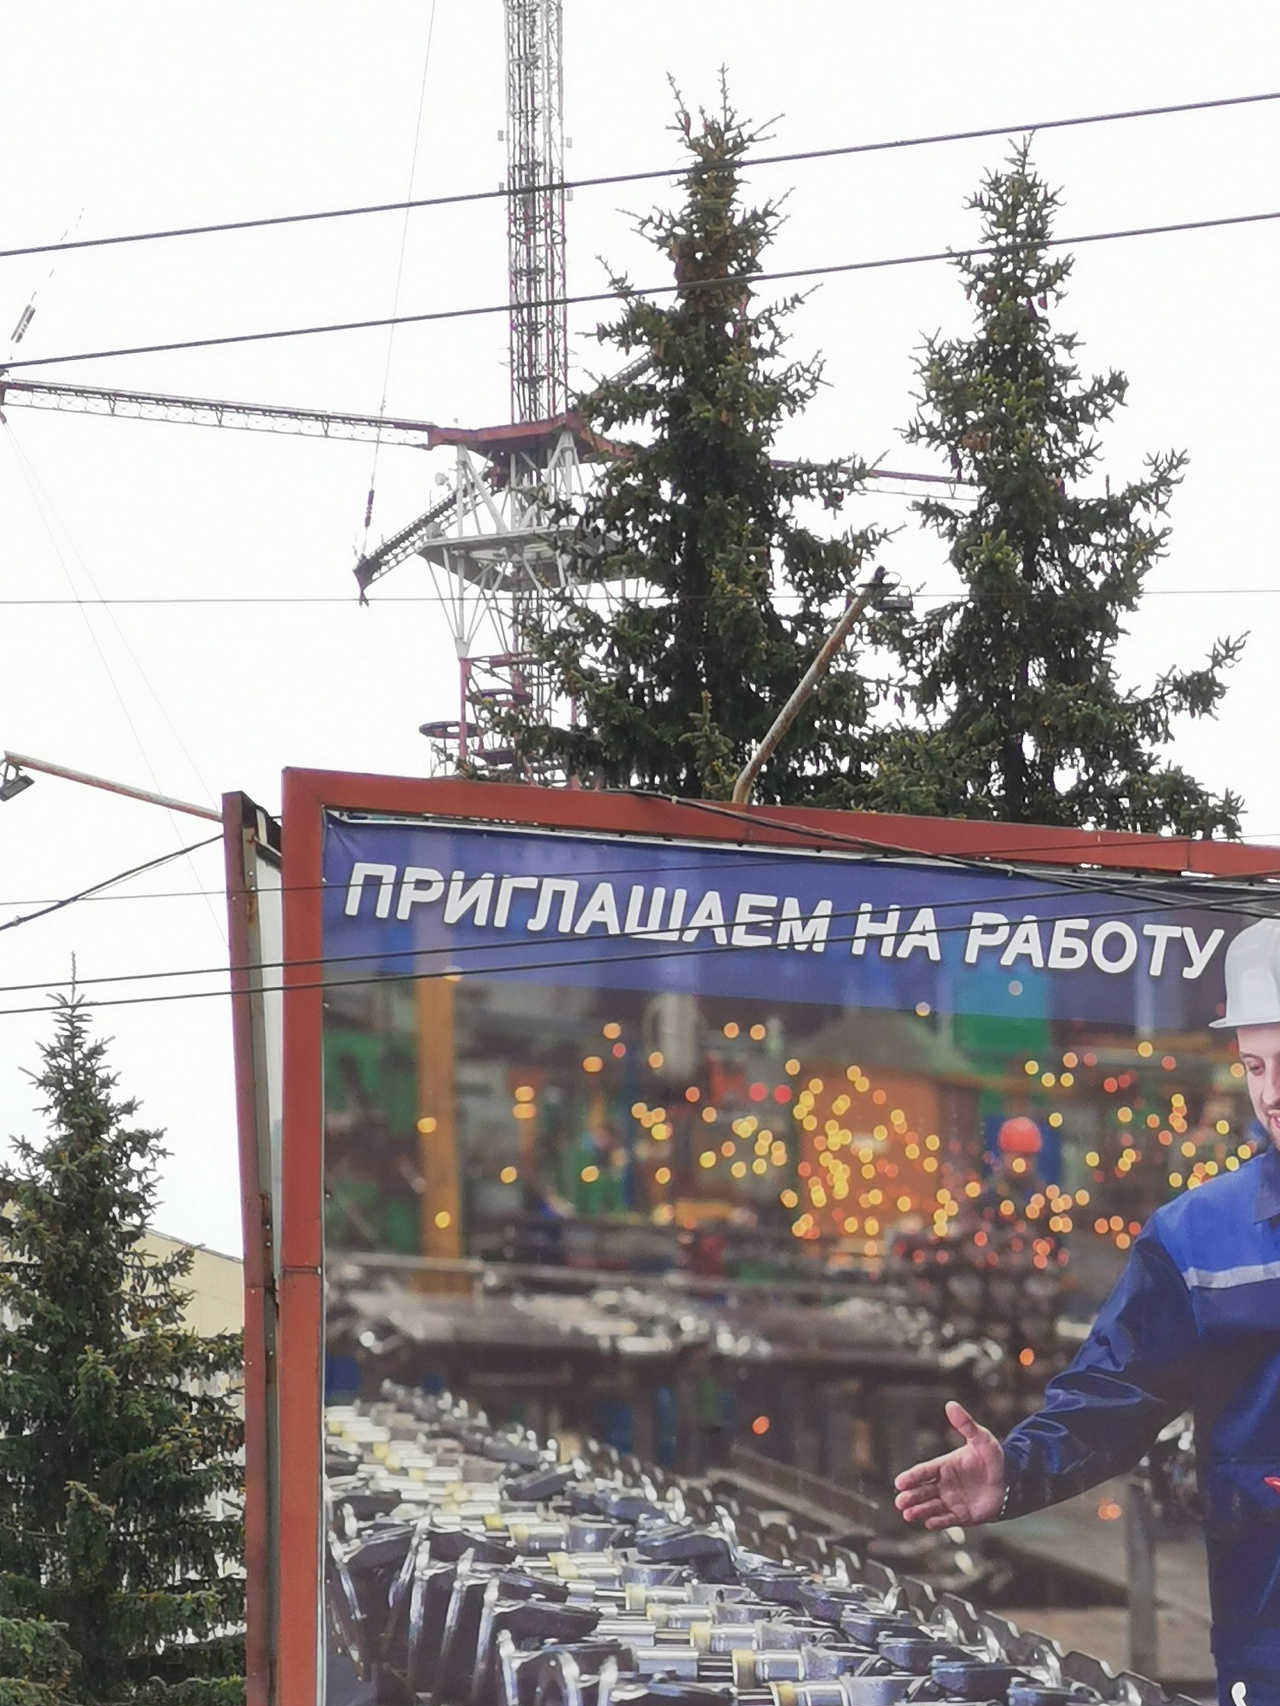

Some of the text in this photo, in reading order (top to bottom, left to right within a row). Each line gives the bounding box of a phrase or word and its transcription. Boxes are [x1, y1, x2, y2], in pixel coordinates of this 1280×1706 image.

[344, 861, 1225, 980] ПРИГЛАШАЕМ НА РАБОТУ
